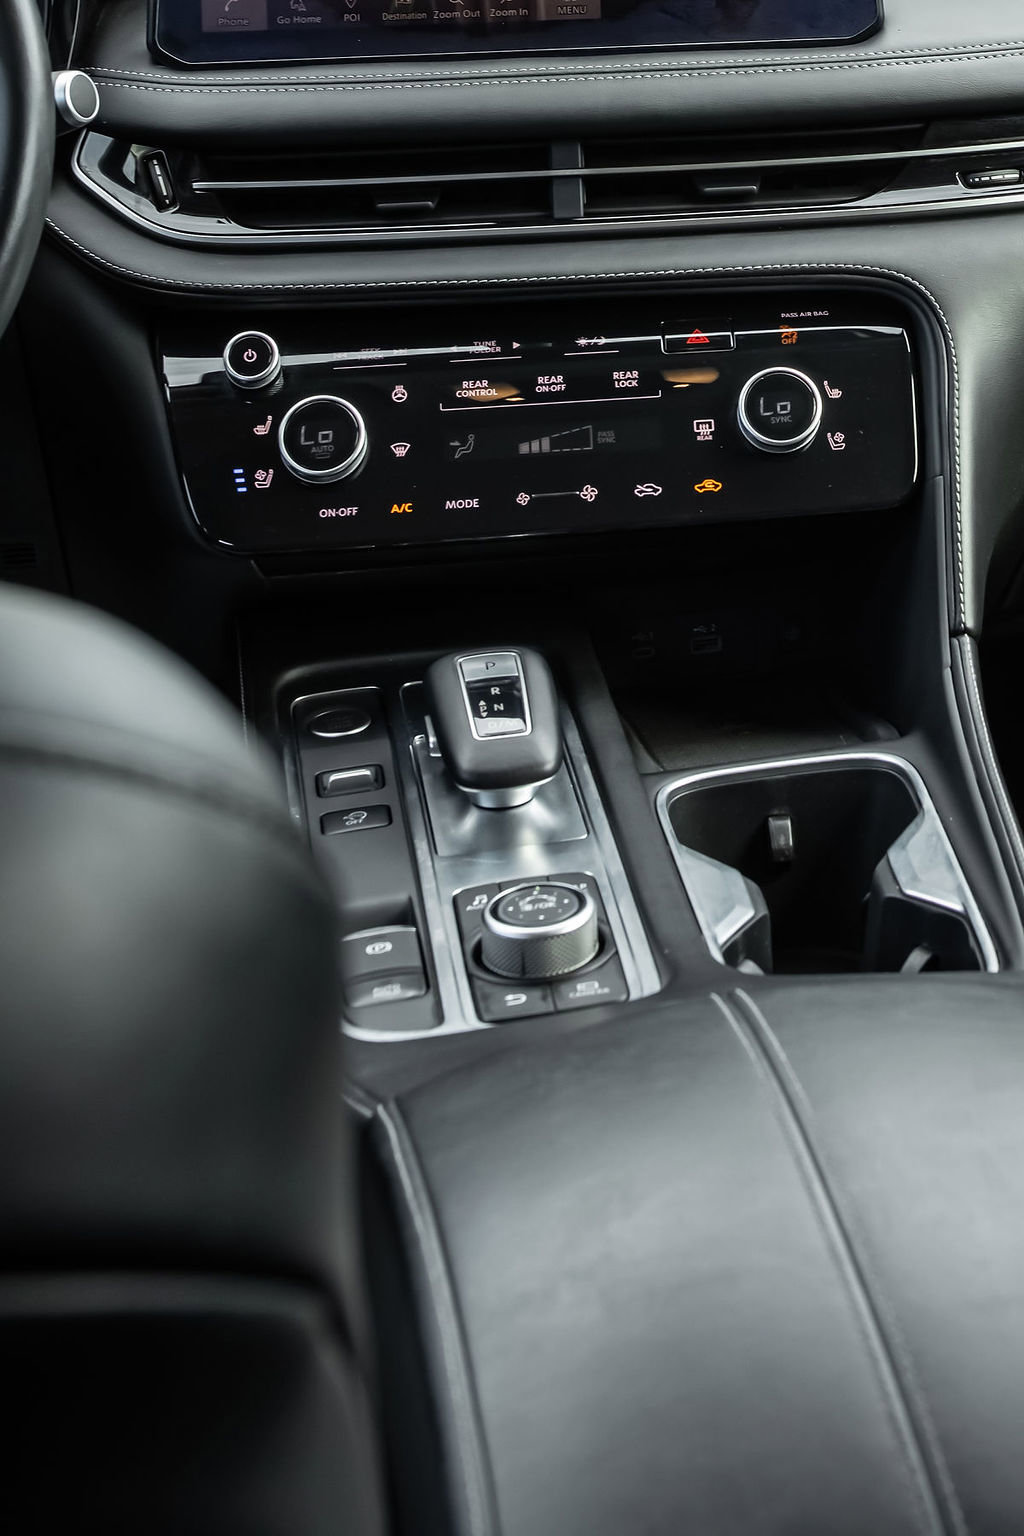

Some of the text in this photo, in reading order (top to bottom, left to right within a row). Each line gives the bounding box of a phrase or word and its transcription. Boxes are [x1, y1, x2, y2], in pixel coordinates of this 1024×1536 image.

[433, 9, 480, 19] Zoom Out
[489, 7, 528, 17] Zoom In
[557, 5, 587, 15] MENU
[277, 15, 322, 25] Go Home
[344, 14, 360, 22] POI
[382, 11, 427, 21] Destination
[218, 18, 249, 27] Phone
[537, 375, 564, 384] REAR
[612, 370, 639, 380] REAR
[462, 380, 489, 389] REAR
[535, 384, 566, 393] ON-OFF
[614, 379, 639, 388] LOCK
[456, 388, 498, 398] CONTROL
[759, 396, 791, 416] Lo
[770, 415, 793, 424] SYNC
[300, 425, 333, 445] Lo
[311, 445, 335, 453] AUTO
[391, 502, 413, 514] A/C
[445, 498, 479, 510] MODE
[319, 506, 358, 518] ON-OFF
[485, 661, 495, 670] P
[490, 686, 501, 695] R
[493, 703, 504, 711] N
